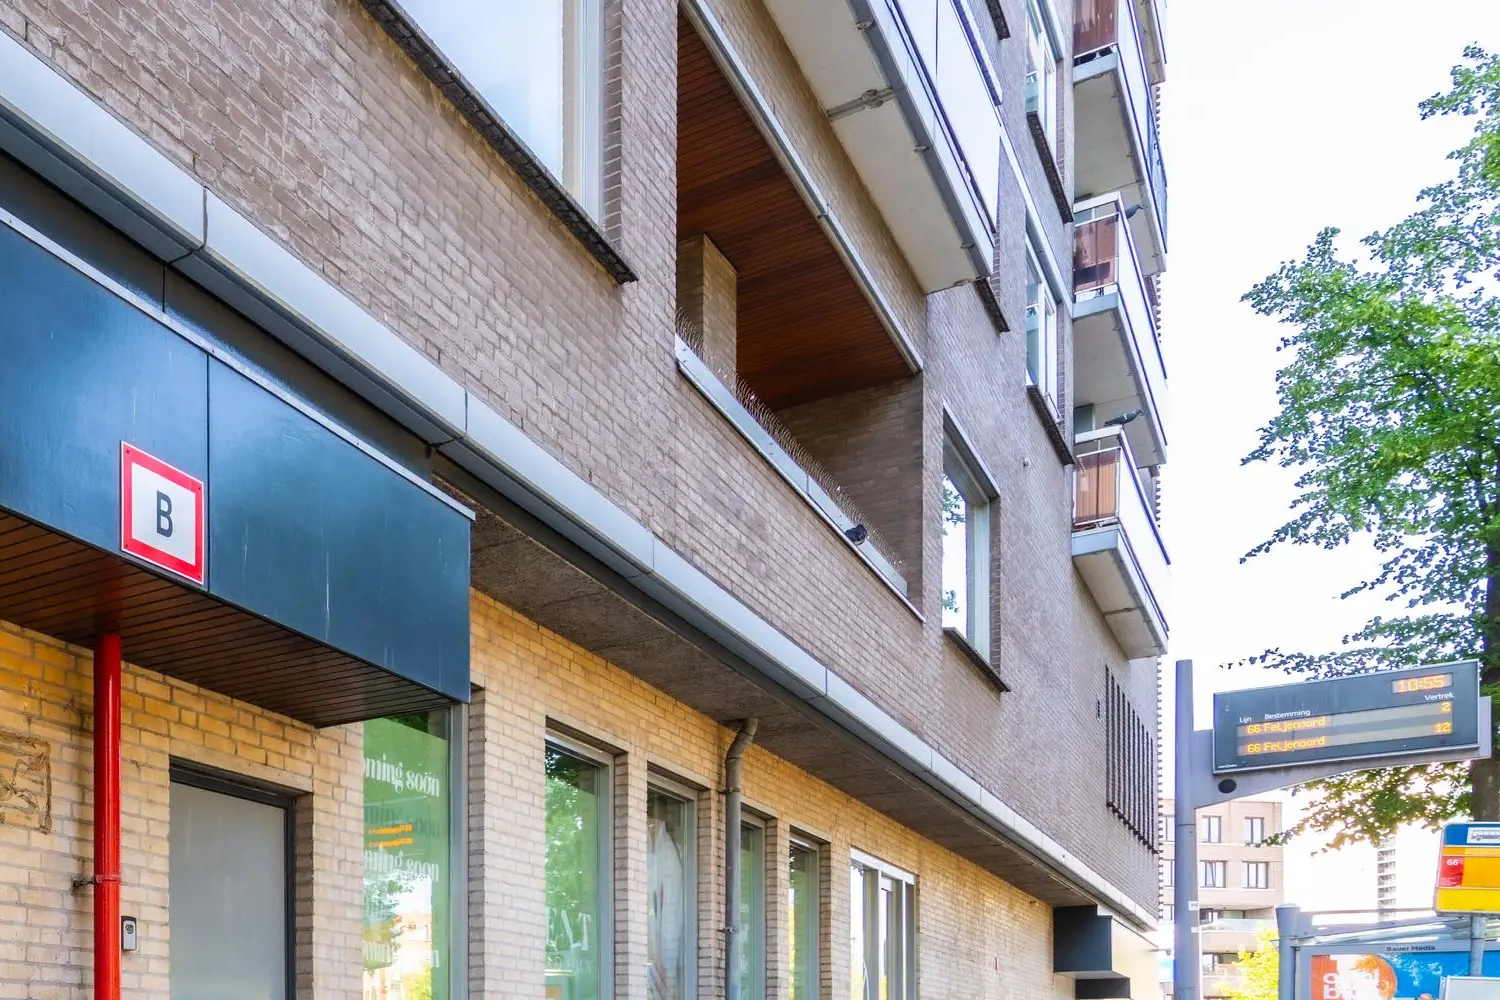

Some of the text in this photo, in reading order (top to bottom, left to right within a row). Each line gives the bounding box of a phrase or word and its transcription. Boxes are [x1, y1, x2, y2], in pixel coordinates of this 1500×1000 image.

[156, 490, 174, 538] B
[1398, 675, 1445, 692] 10:55
[1424, 691, 1454, 702] Vertrek
[1442, 702, 1451, 712] 2
[1239, 709, 1311, 724] Lijn Bestemming
[1247, 716, 1325, 734] 66 Feijenoord
[1436, 722, 1451, 733] 12
[1247, 736, 1325, 754] 66 Feijenoord
[363, 754, 403, 793] ming
